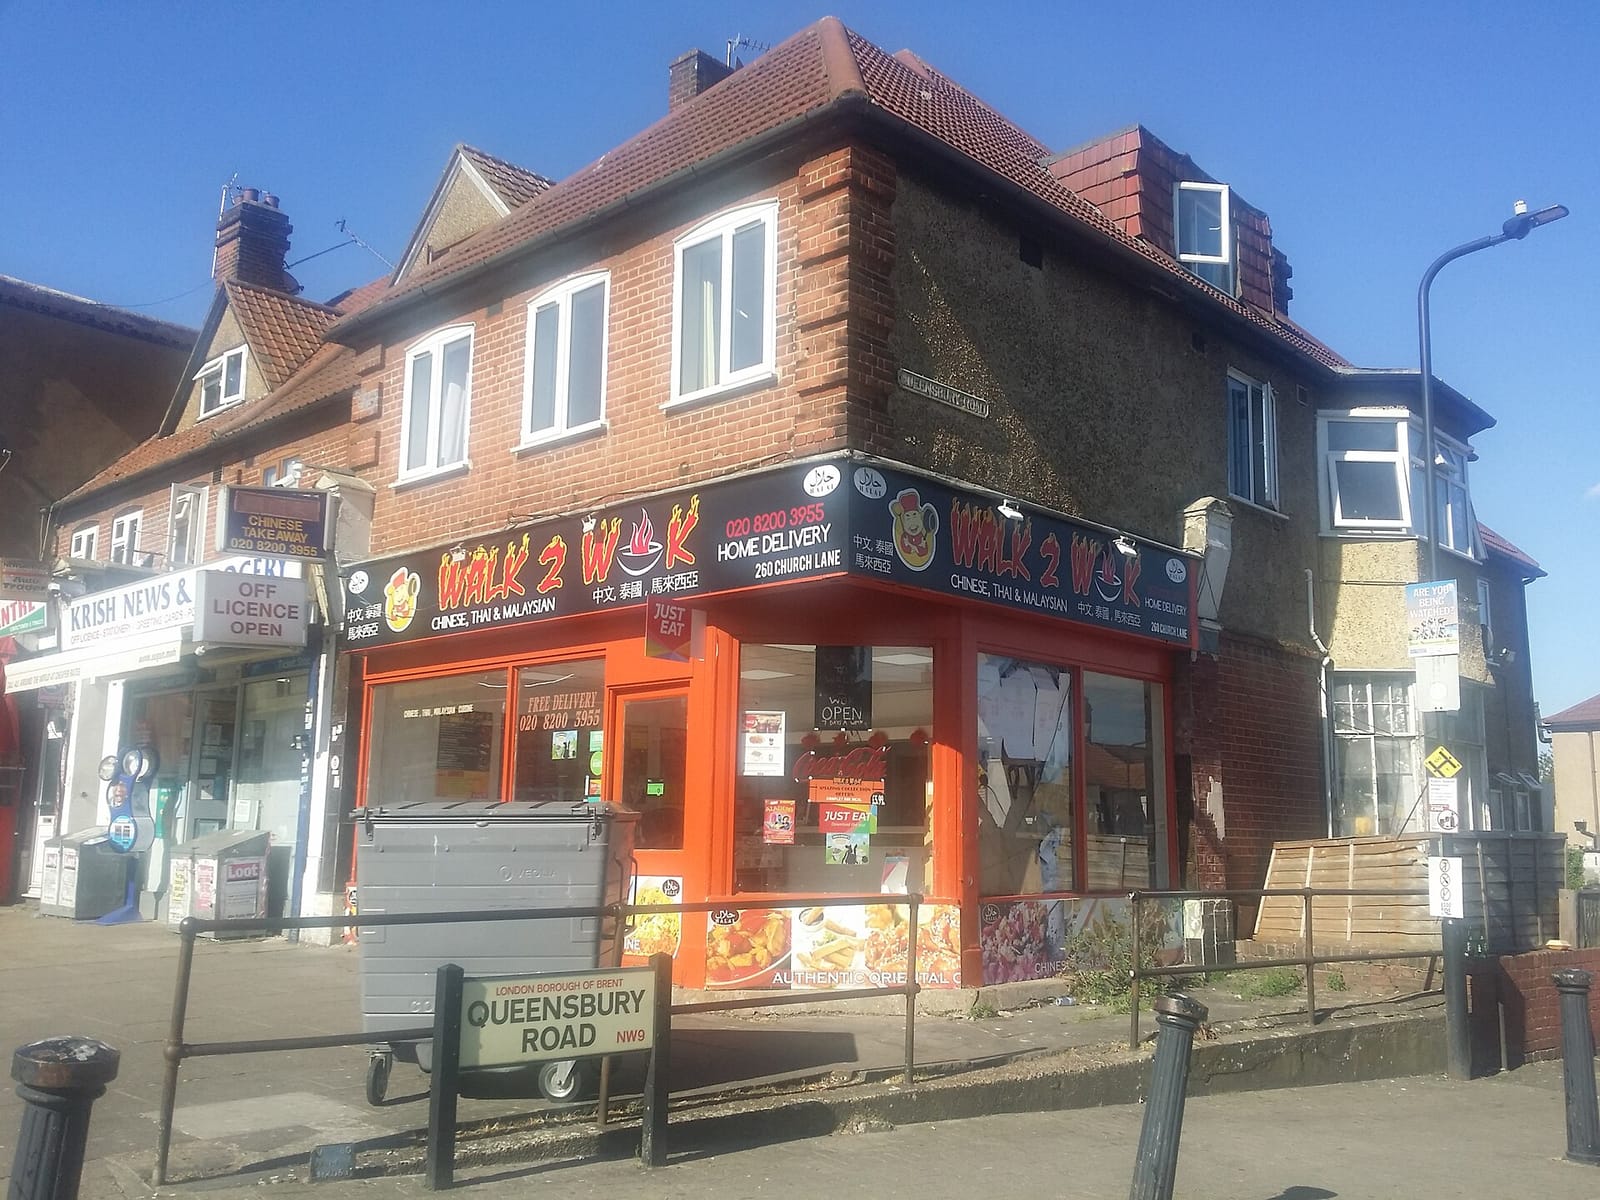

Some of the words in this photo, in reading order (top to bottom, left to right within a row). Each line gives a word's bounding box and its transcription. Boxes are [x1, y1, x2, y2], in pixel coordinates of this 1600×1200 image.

[248, 515, 304, 532] CHINESE
[725, 517, 751, 540] 020
[752, 511, 787, 533] 8200
[788, 502, 825, 526] 3955
[242, 526, 309, 544] TAKEAWAY
[717, 538, 760, 562] HOME
[761, 522, 832, 554] DELIVERY
[950, 495, 1032, 582] WALK
[1039, 531, 1061, 588] 2
[231, 537, 254, 550] 020
[256, 540, 287, 553] 8200
[288, 545, 318, 557] 3955
[437, 532, 530, 611] WALK
[536, 533, 568, 594] 2
[754, 560, 774, 579] 260
[774, 554, 814, 576] CHURCH
[814, 549, 842, 569] LANE
[855, 552, 892, 574] 馬來西亞
[238, 581, 277, 599] OFF
[650, 570, 699, 594] 馬來西亞
[1413, 586, 1430, 598] ARE
[950, 573, 992, 599] CHINESE,
[992, 584, 1013, 602] THAI
[1014, 588, 1022, 603] &
[1023, 591, 1069, 613] MALAYSIAN
[1418, 596, 1445, 607] BEING
[70, 596, 116, 632] KRISH
[123, 581, 171, 620] NEWS
[176, 577, 193, 606] &
[213, 599, 299, 620] LICENCE
[431, 612, 470, 632] CHINESE,
[471, 609, 492, 625] THAI
[493, 608, 501, 621] &
[502, 596, 557, 618] MALAYSIAN
[653, 602, 687, 622] JUST
[1144, 597, 1163, 611] HOME
[1162, 600, 1188, 617] DELIVERY
[1409, 605, 1455, 619] WATCHED?
[230, 621, 283, 637] OPEN
[659, 620, 685, 638] EAT
[527, 695, 552, 713] FREE
[551, 691, 599, 710] DELIVERY
[518, 713, 538, 731] 020
[542, 712, 568, 730] 8200
[572, 708, 602, 728] 3955
[821, 706, 863, 720] OPEN
[824, 811, 851, 822] JUST
[852, 812, 873, 821] EAT
[228, 863, 259, 879] Loot
[1034, 960, 1067, 974] CHINES
[495, 984, 535, 997] LONDON
[536, 981, 581, 994] BOROUGH
[582, 980, 595, 989] OF
[596, 978, 624, 989] BRENT
[771, 971, 866, 985] AUTHENTIC
[867, 971, 950, 985] ORIETAL
[467, 989, 647, 1028] QUEENSBURY
[521, 1022, 597, 1053] ROAD
[616, 1028, 646, 1044] NW9
